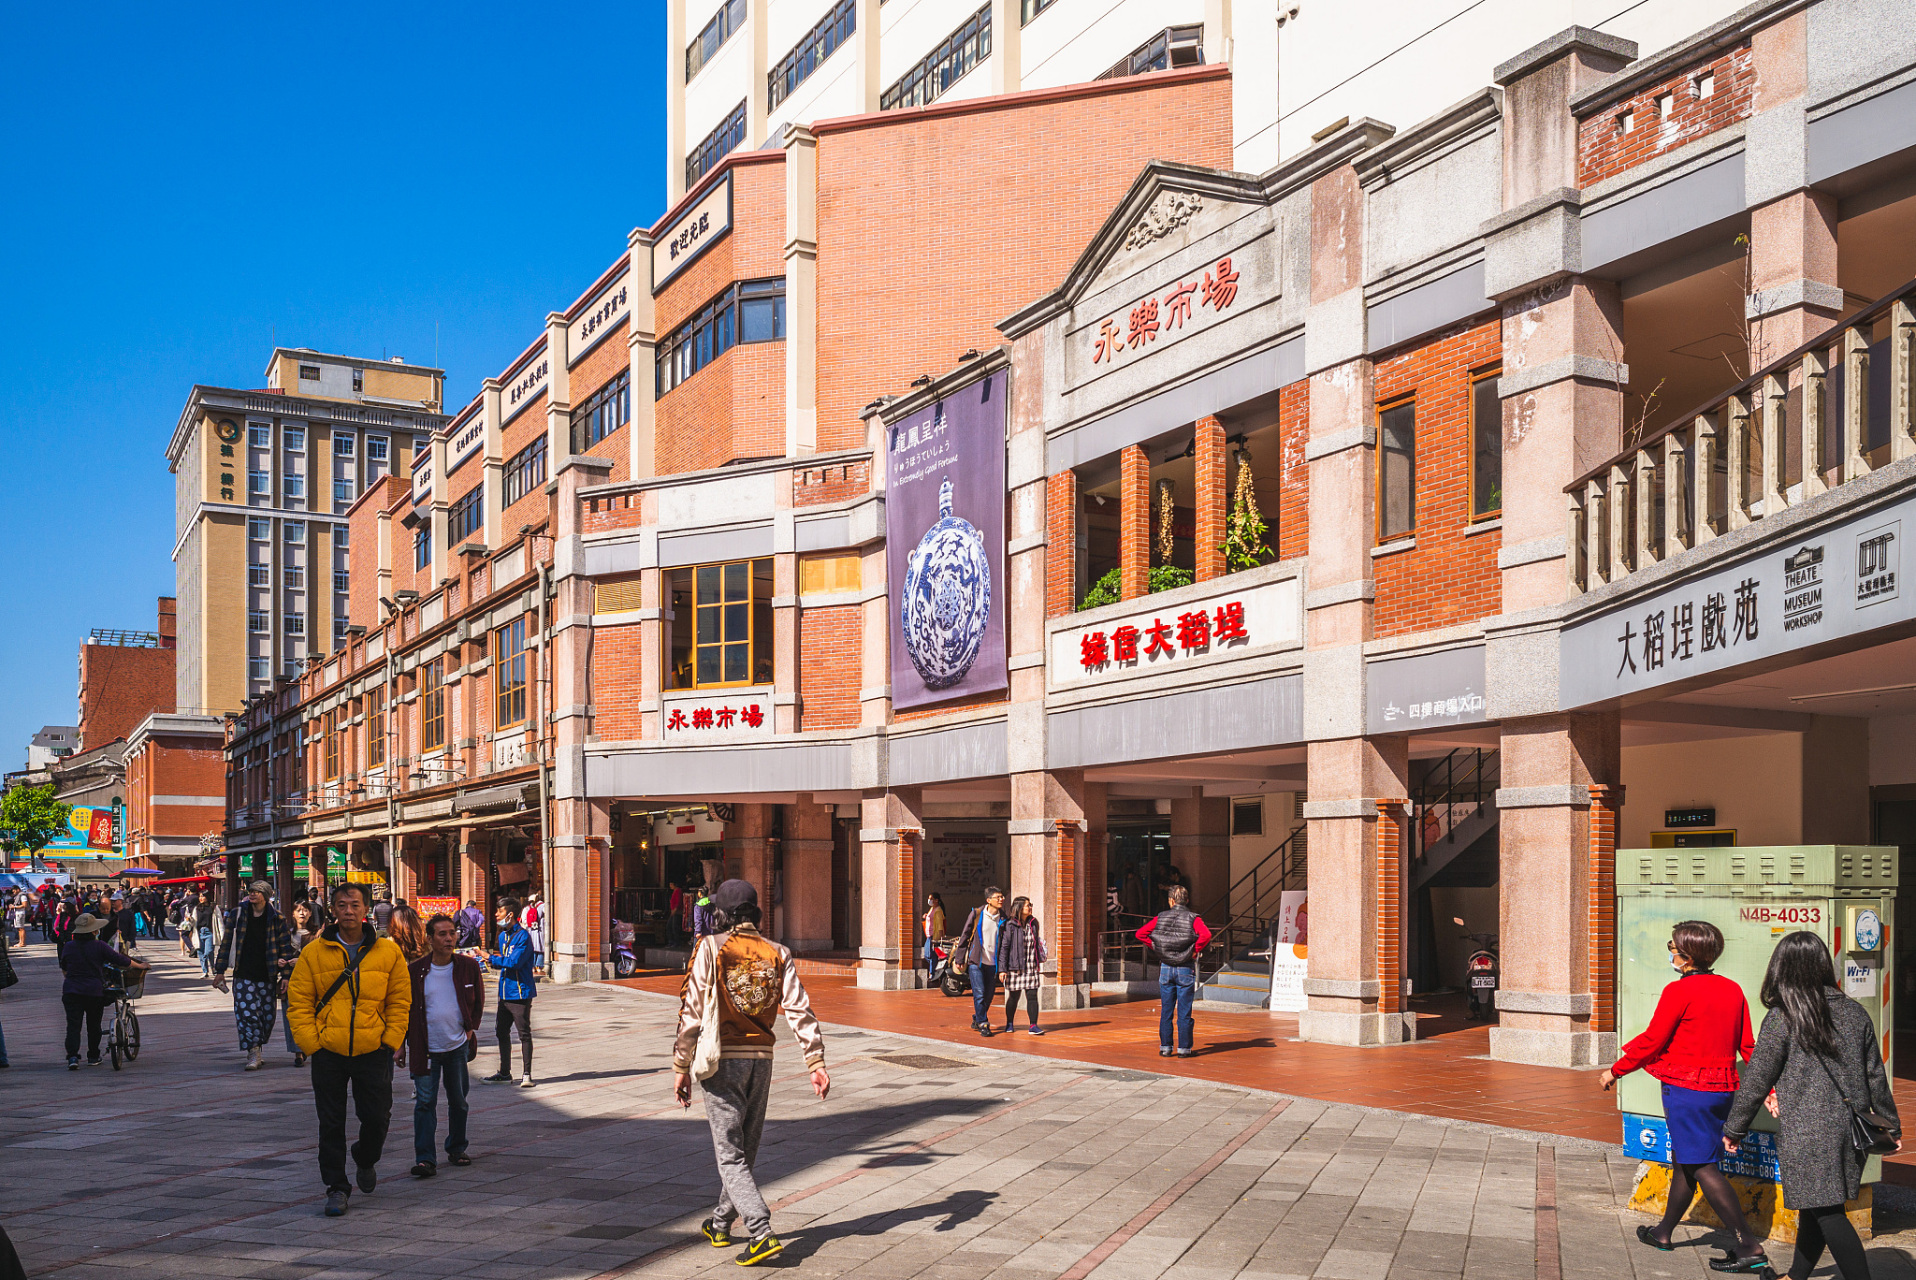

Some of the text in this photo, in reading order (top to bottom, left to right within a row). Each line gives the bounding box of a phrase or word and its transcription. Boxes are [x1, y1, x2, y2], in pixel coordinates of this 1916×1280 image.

[670, 211, 709, 261] 歡迎光臨
[1092, 257, 1239, 364] 永樂市場
[894, 412, 948, 456] 龍鳳呈祥
[220, 443, 235, 502] 第一銀行
[924, 460, 938, 475] Good
[938, 453, 959, 469] Fortune
[1784, 588, 1822, 613] MUSEUM
[1617, 577, 1760, 680] 大稻埕戲苑
[1783, 610, 1823, 633] WORKSHOP
[666, 704, 765, 733] 永樂市場
[112, 806, 120, 844] 第一銀行
[1740, 908, 1821, 923] N4B-4033
[1847, 966, 1870, 977] Wi-Fi
